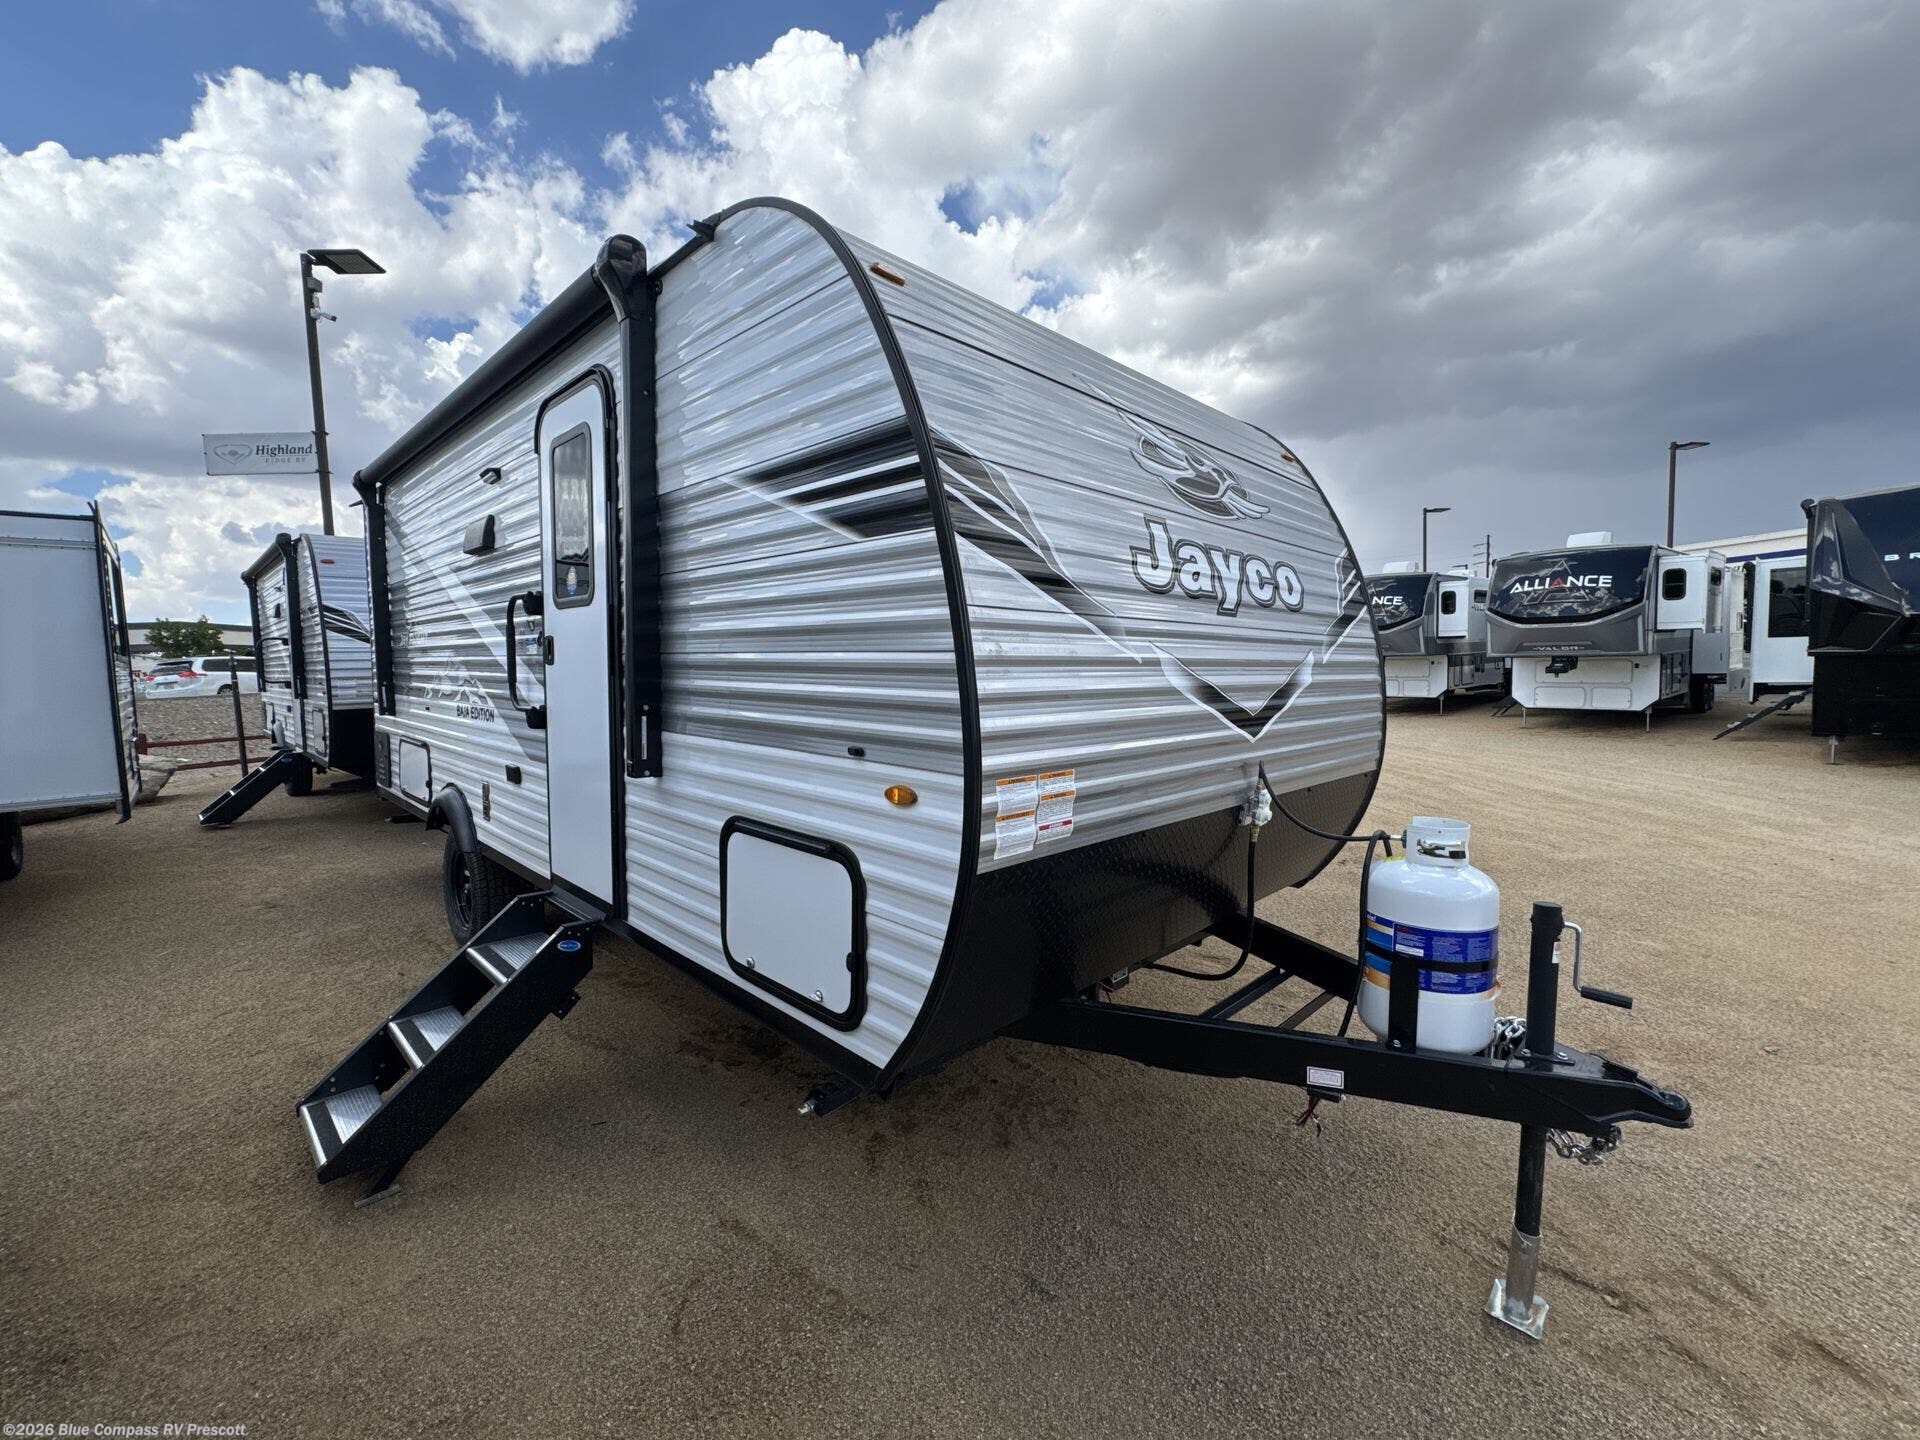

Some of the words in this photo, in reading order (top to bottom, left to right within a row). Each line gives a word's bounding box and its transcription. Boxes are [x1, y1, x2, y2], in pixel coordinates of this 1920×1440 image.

[256, 444, 312, 457] Highland
[1129, 513, 1304, 617] Jayco
[1509, 575, 1613, 594] ALLIANCE
[1372, 596, 1403, 605] NCE
[456, 705, 470, 718] BAJA
[470, 706, 495, 722] EDITION
